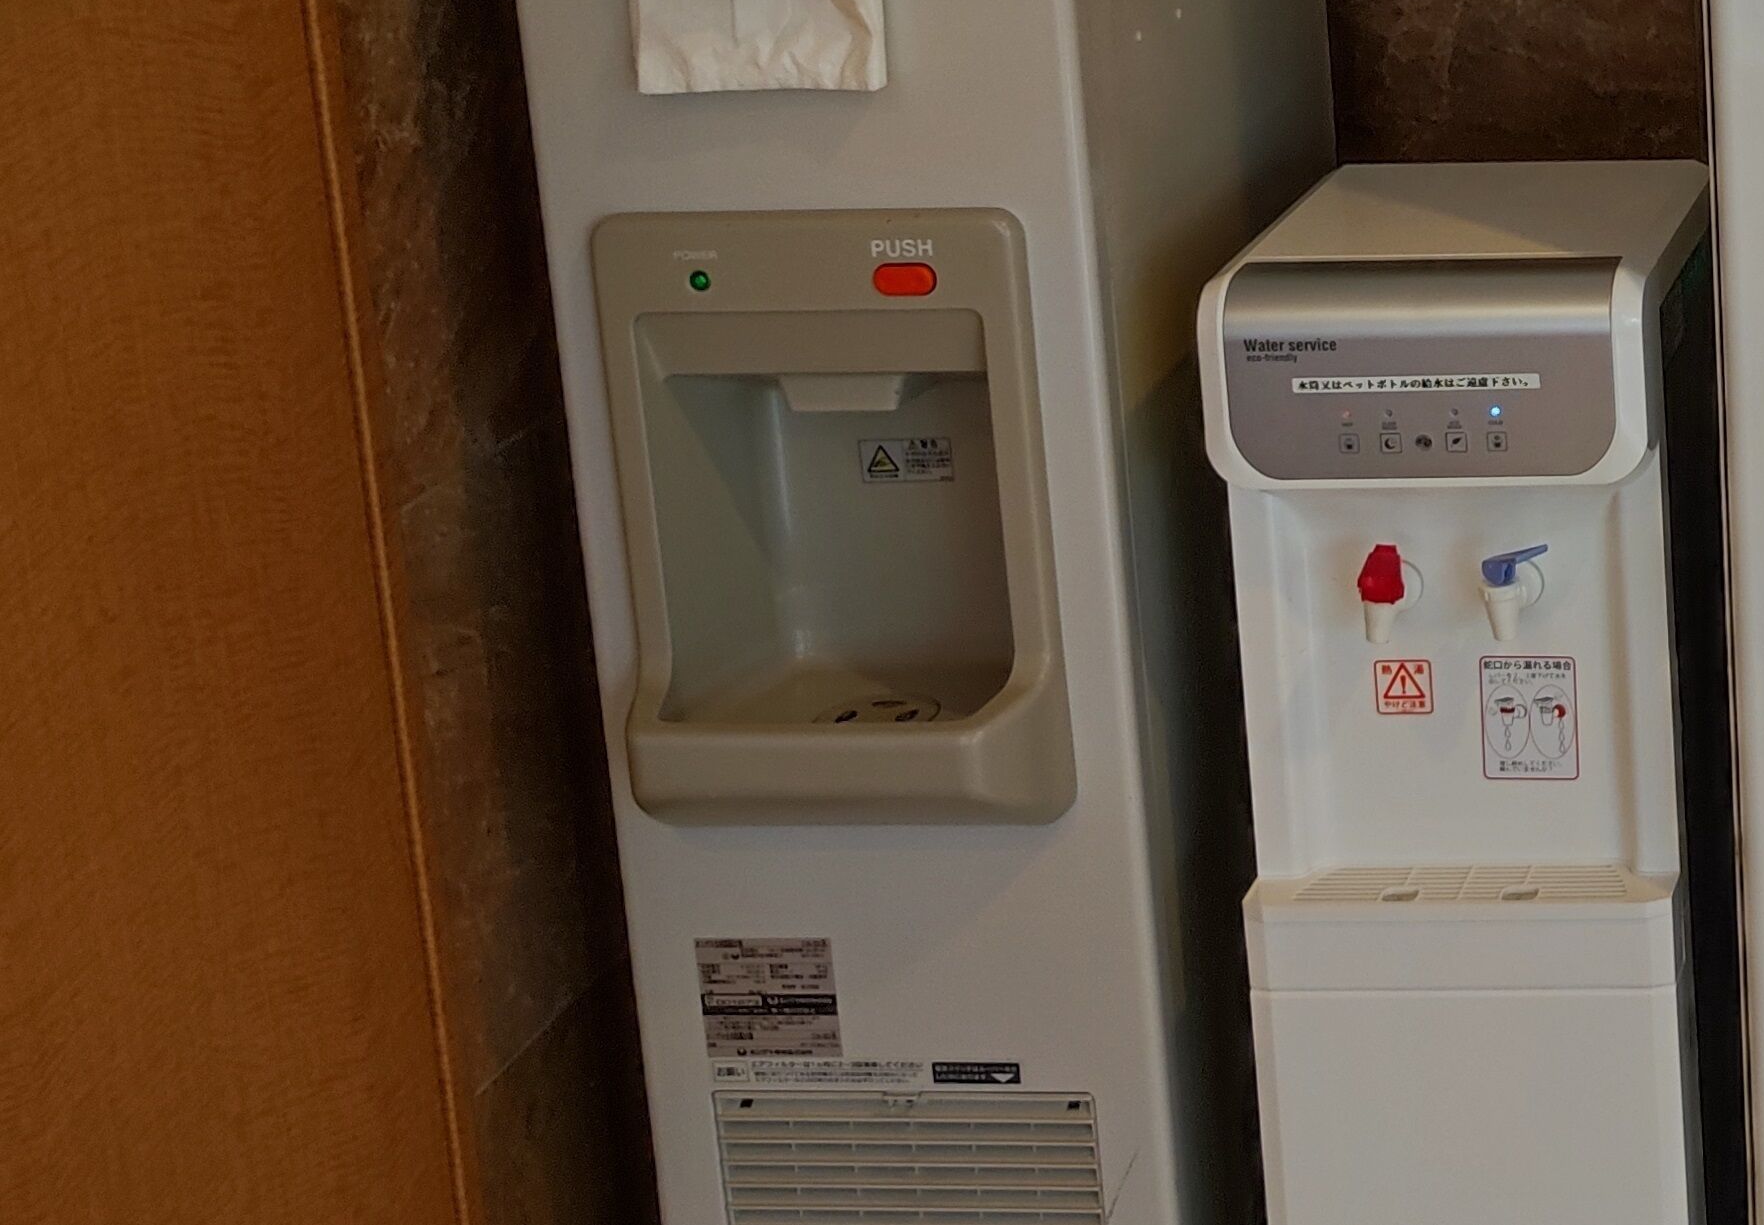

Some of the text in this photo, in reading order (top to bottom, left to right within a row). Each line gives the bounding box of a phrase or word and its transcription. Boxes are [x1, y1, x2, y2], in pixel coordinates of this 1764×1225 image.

[673, 249, 718, 261] POWER
[870, 239, 934, 258] PUSH
[1243, 338, 1338, 353] Water service
[1246, 353, 1298, 364] eco-friendly
